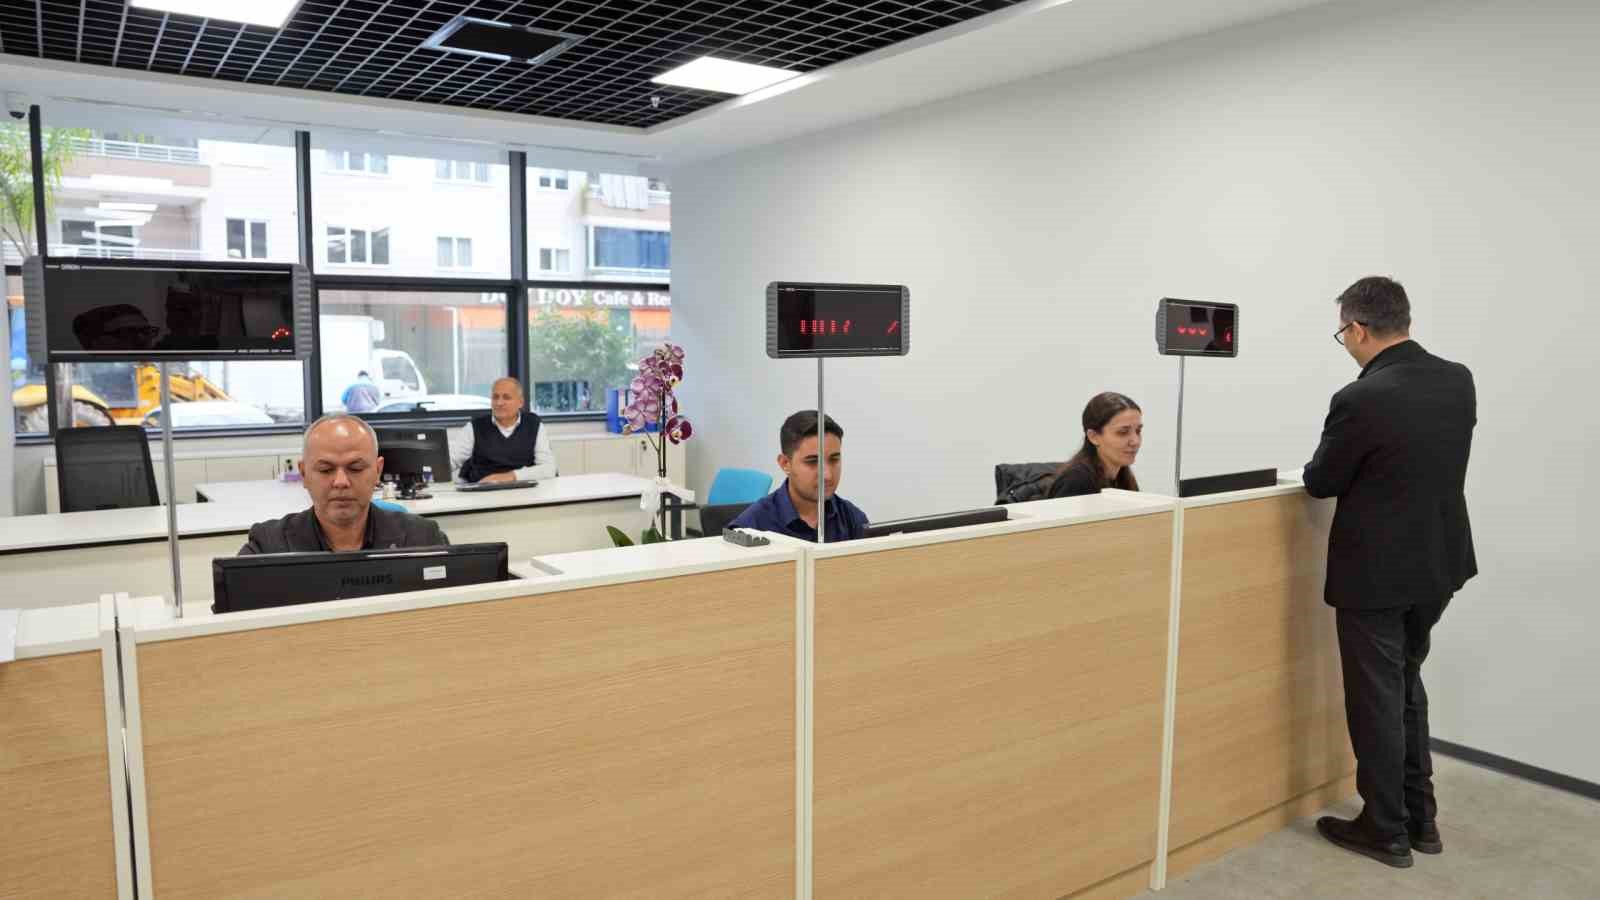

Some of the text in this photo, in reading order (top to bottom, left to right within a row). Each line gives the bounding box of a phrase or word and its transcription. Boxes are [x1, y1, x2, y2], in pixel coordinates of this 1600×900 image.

[537, 287, 585, 306] DOY
[592, 290, 629, 306] Cafe
[632, 291, 645, 307] &
